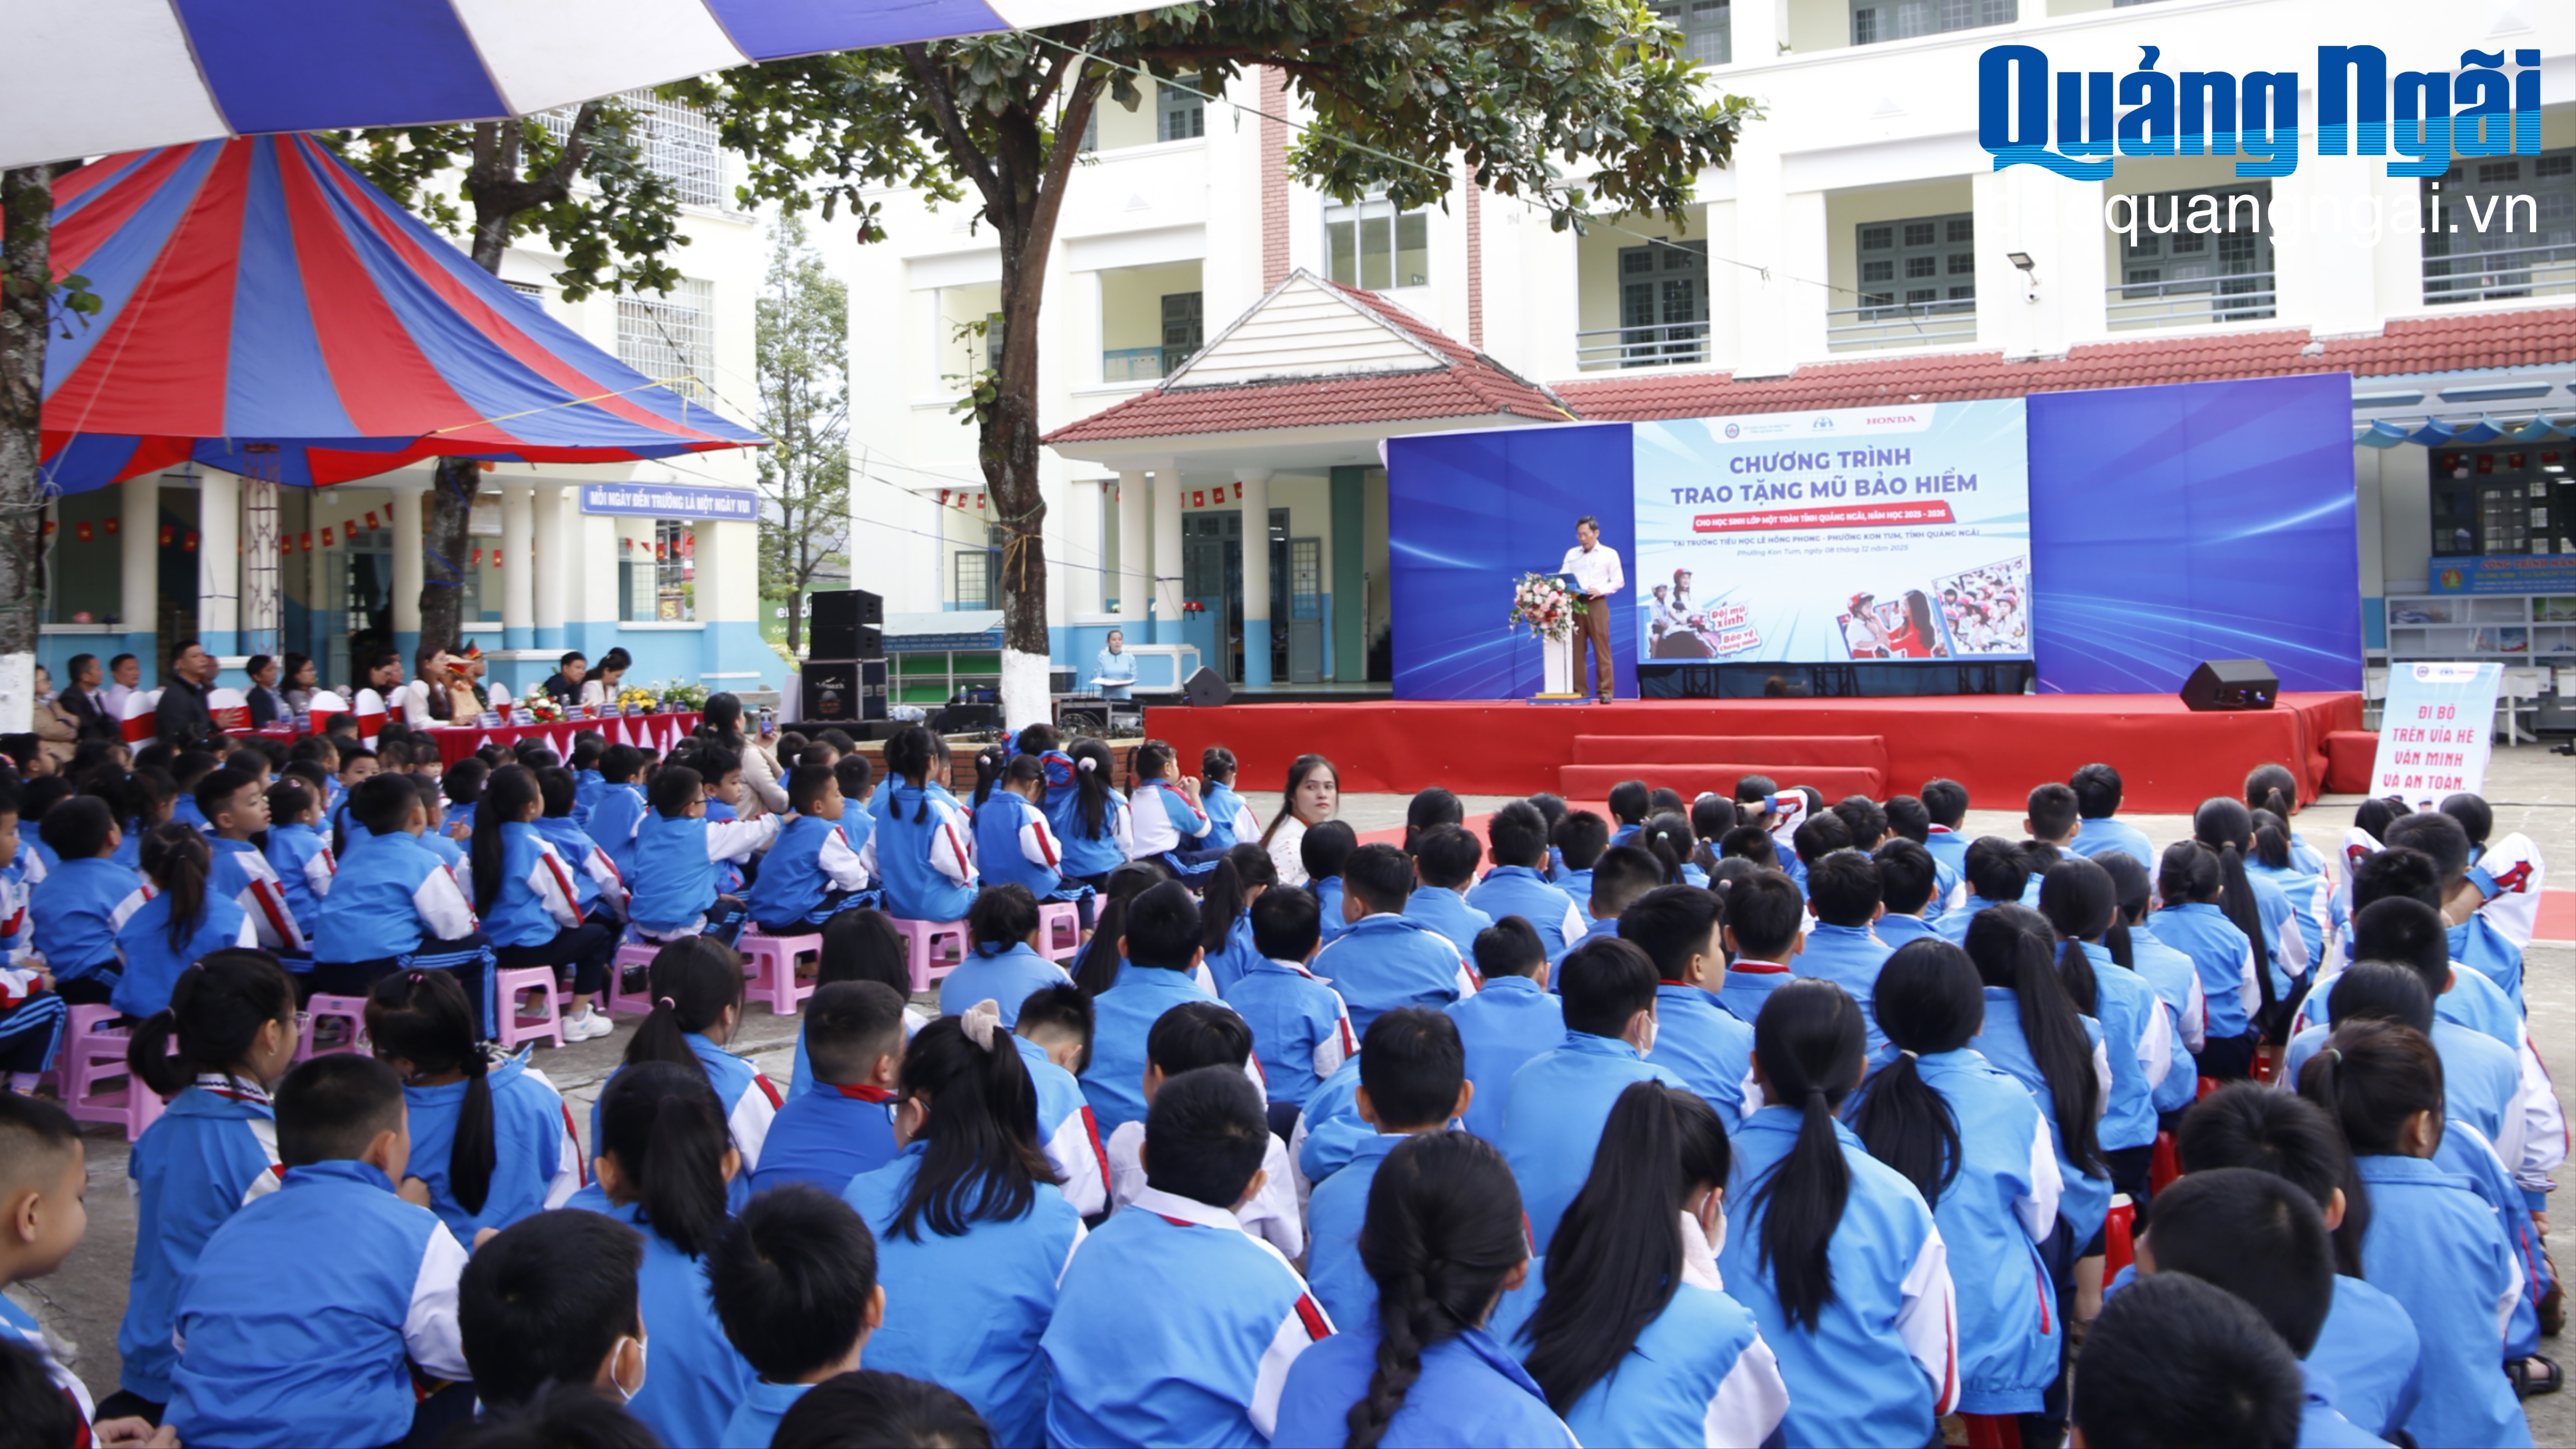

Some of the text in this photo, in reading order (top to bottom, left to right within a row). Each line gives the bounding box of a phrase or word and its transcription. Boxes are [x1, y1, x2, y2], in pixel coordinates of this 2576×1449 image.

[1866, 415, 1917, 425] HONDA
[1730, 444, 1912, 474] CHƯƠNG TRÌNH
[1671, 467, 1978, 506] TRAO TẶNG MŨ BẢO HIỂM
[608, 489, 631, 506] NGÀY
[632, 488, 650, 508] ĐẾN
[651, 491, 684, 509] TRƯỜNG
[686, 493, 695, 510] LÀ
[697, 494, 714, 515] MỘT
[715, 495, 736, 512] NGÀY
[738, 499, 751, 513] VUI
[1695, 518, 1711, 527] CHO
[1712, 518, 1728, 527] HỌC
[1729, 517, 1745, 526] SINH
[1779, 513, 1799, 523] TOÀN
[1904, 509, 1922, 518] 2025
[1927, 509, 1946, 518] 2026
[2418, 703, 2456, 723] ĐI BỘ
[2393, 725, 2425, 743] TRÊN
[2456, 726, 2475, 744] HÈ
[2395, 749, 2464, 767] VĂN MINH
[2383, 772, 2466, 791] VÀ AN TOÀN.
